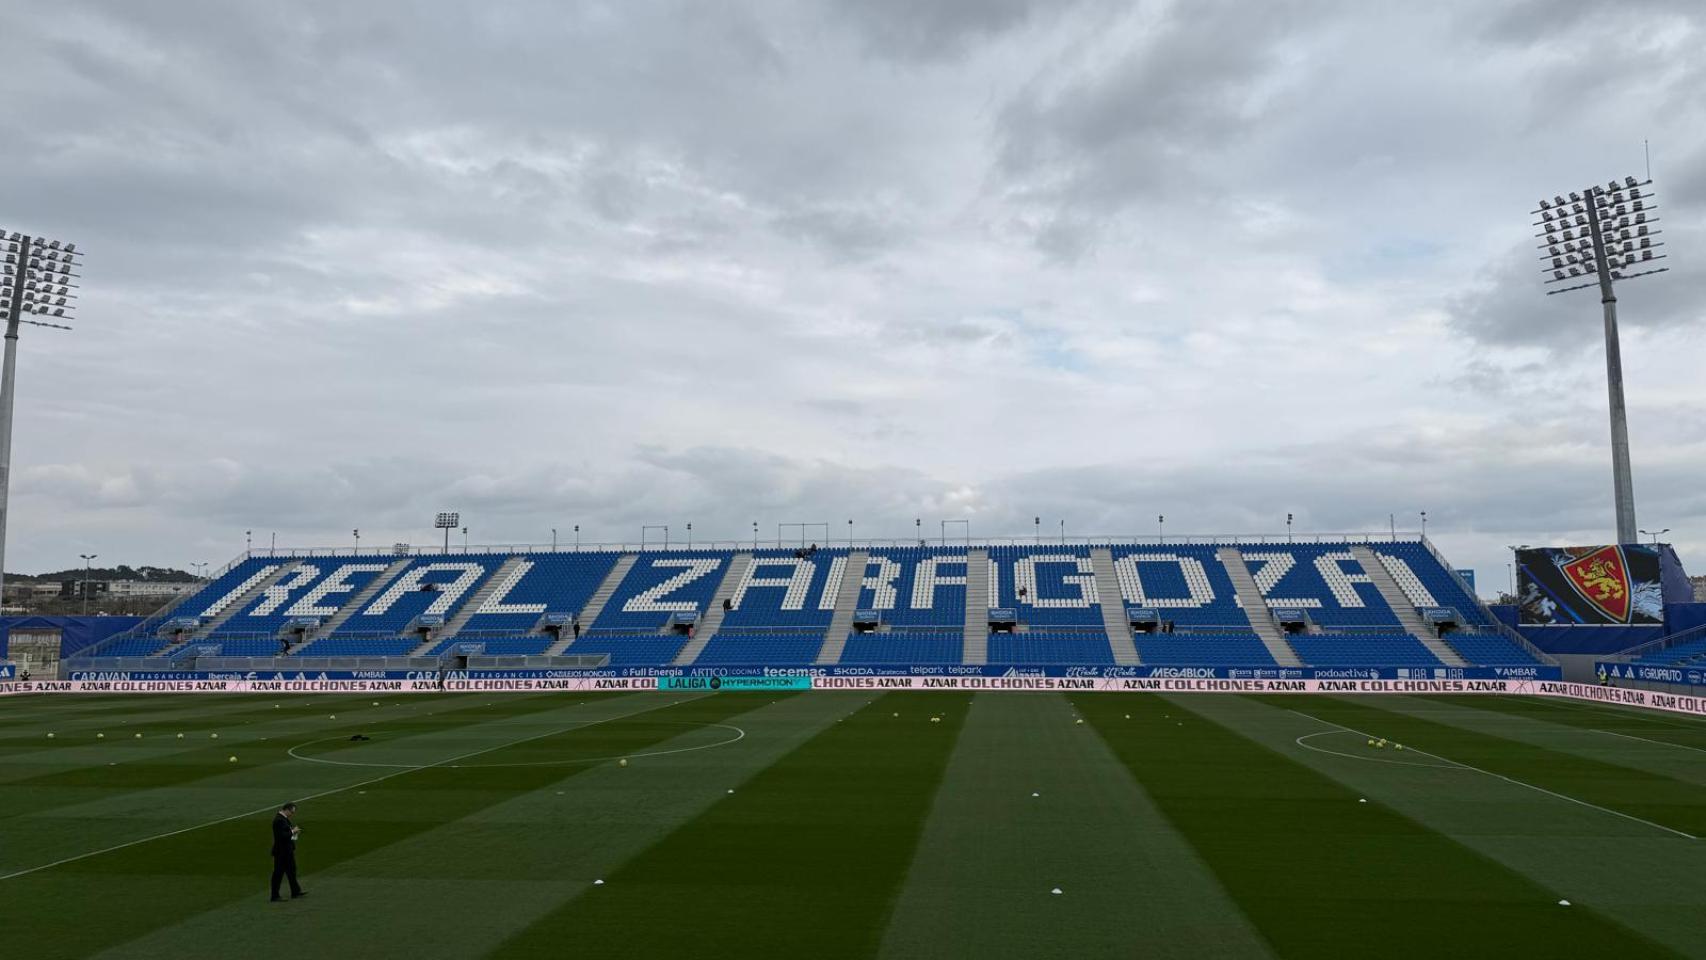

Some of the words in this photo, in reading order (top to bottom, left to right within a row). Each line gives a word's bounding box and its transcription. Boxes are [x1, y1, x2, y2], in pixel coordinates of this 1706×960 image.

[200, 561, 548, 616] REAL
[622, 551, 1438, 611] ZARAGOZA
[358, 671, 386, 679] AMBAR
[764, 667, 827, 677] tecemac
[910, 666, 944, 675] telpark
[949, 666, 982, 675] telpark
[1150, 668, 1215, 678] MEGABLOK
[1314, 668, 1368, 679] podoactiva
[1503, 668, 1538, 676] AMBAR
[72, 672, 130, 681] CARAVAN
[35, 682, 71, 691] AZNAR
[80, 682, 111, 690] AZNAR
[113, 682, 193, 691] COLCHONES
[196, 682, 226, 690] AZNAR
[250, 682, 281, 690] AZNAR
[284, 681, 367, 691] COLCHONES
[369, 681, 402, 690] AZNAR
[447, 680, 533, 689] COLCHONES
[535, 680, 569, 689] AZNAR
[594, 679, 628, 688] AZNAR
[668, 678, 706, 689] LALIGA
[722, 678, 794, 687] HYPERMOTION
[813, 678, 874, 688] CHONES
[876, 678, 912, 687] AZNAR
[922, 678, 957, 687] AZNAR
[961, 678, 1054, 688] COLCHONES
[1057, 679, 1095, 688] AZNAR
[1123, 680, 1161, 689] AZNAR
[1164, 680, 1264, 690] COLCHONES
[1267, 681, 1306, 690] AZNAR
[1318, 681, 1357, 691] AZNAR
[1360, 681, 1463, 691] COLCHONES
[1466, 681, 1506, 691] AZNAR
[1539, 683, 1568, 695] AZNAR
[1569, 684, 1621, 701] COLCHONES
[1622, 692, 1645, 705] AZNAR
[1651, 695, 1676, 709] AZNAR
